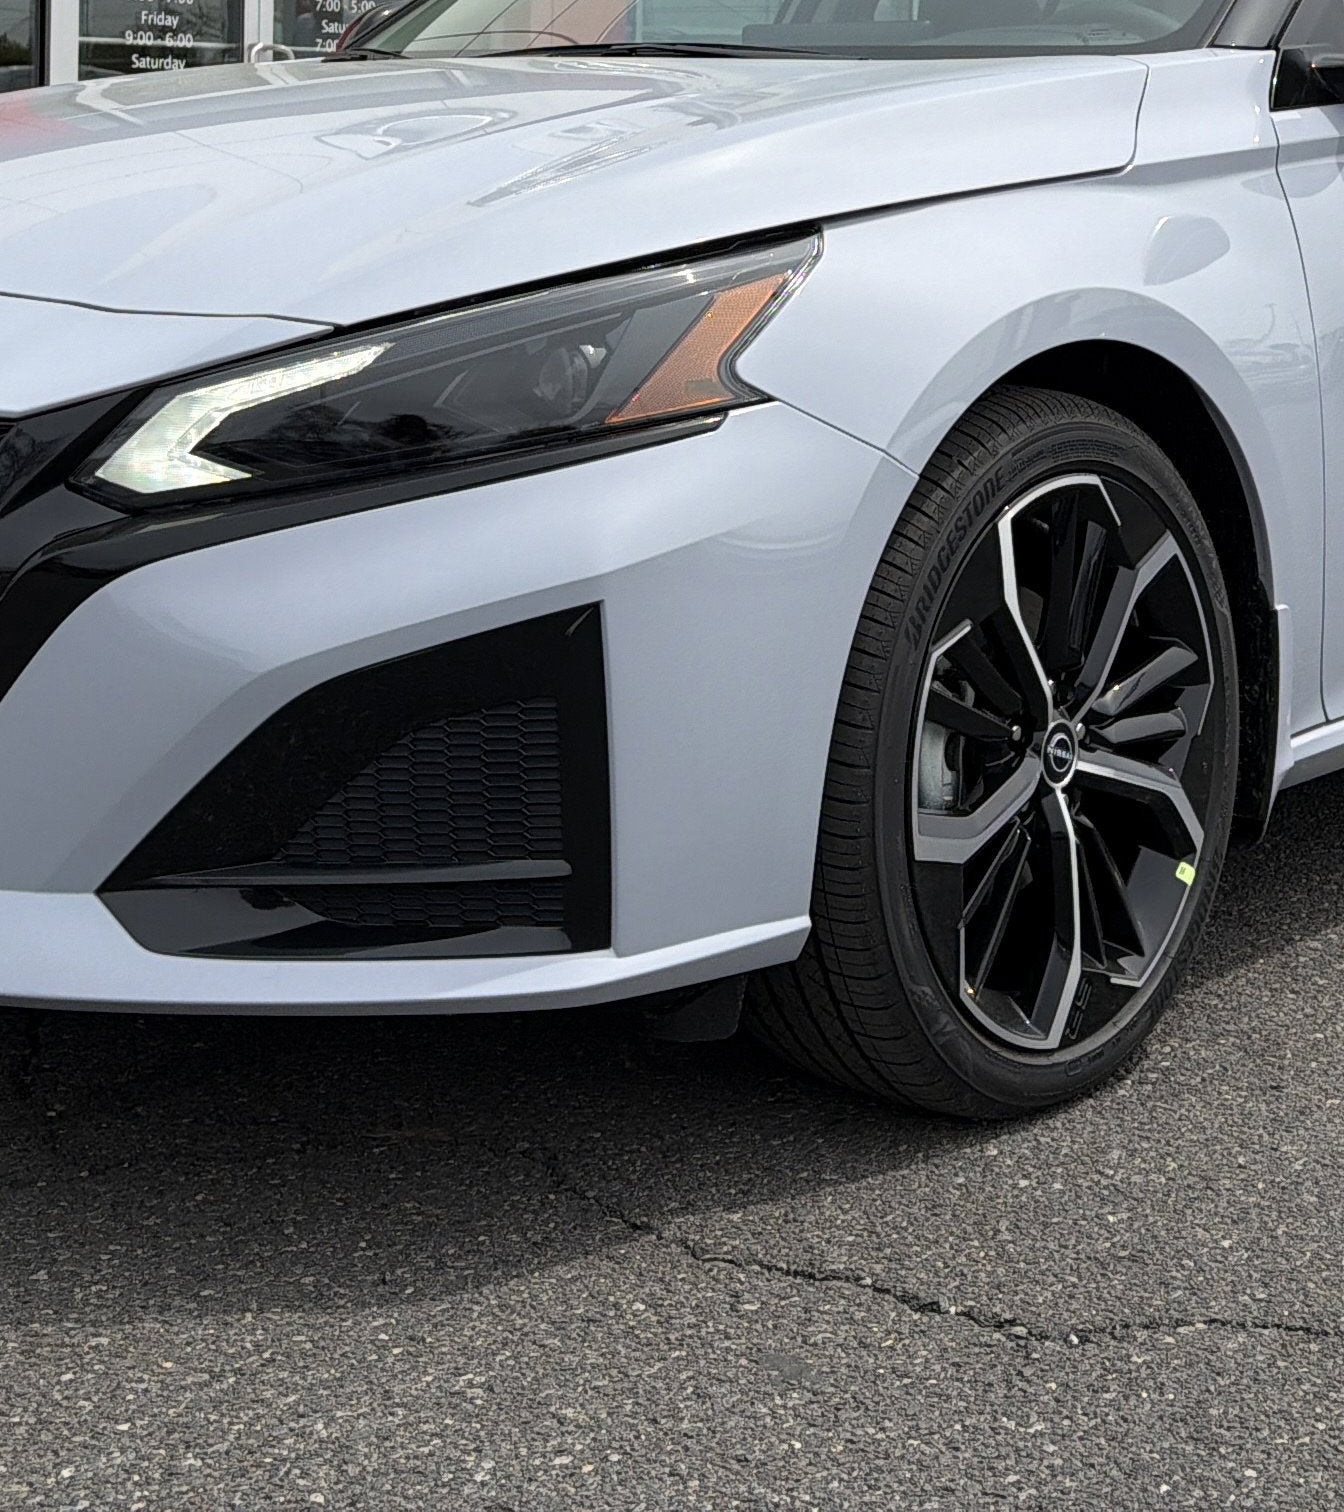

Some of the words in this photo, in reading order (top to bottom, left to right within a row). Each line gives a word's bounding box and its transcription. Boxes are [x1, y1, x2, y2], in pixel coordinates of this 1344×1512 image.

[141, 11, 179, 29] Friday
[321, 19, 349, 34] Satu
[125, 30, 154, 46] 9:00
[165, 33, 194, 48] 6:00
[131, 54, 186, 70] Saturday
